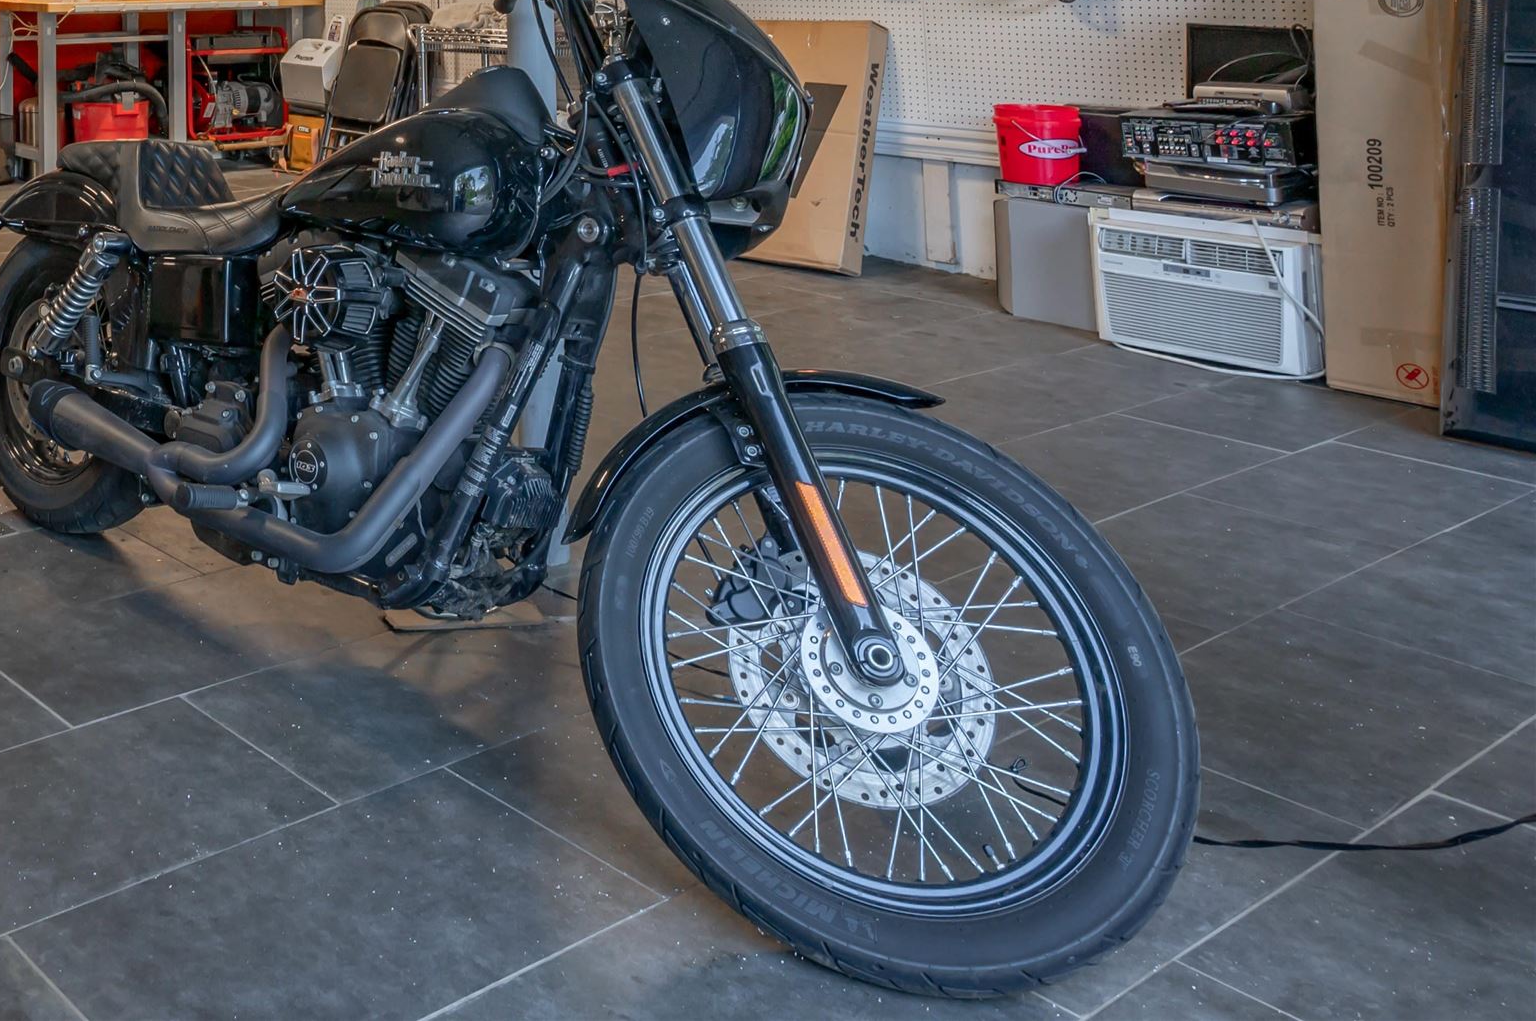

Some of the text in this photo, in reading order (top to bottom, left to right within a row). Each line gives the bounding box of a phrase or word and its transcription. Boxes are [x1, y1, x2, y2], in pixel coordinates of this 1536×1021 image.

[850, 63, 880, 238] WeatherTech
[1366, 138, 1384, 190] 100209
[1386, 186, 1394, 201] PCS
[1377, 209, 1385, 227] ITEM
[296, 460, 315, 473] 103
[1127, 645, 1142, 667] E90
[1128, 769, 1161, 850] SCORCHER
[699, 820, 837, 924] MICHELIN
